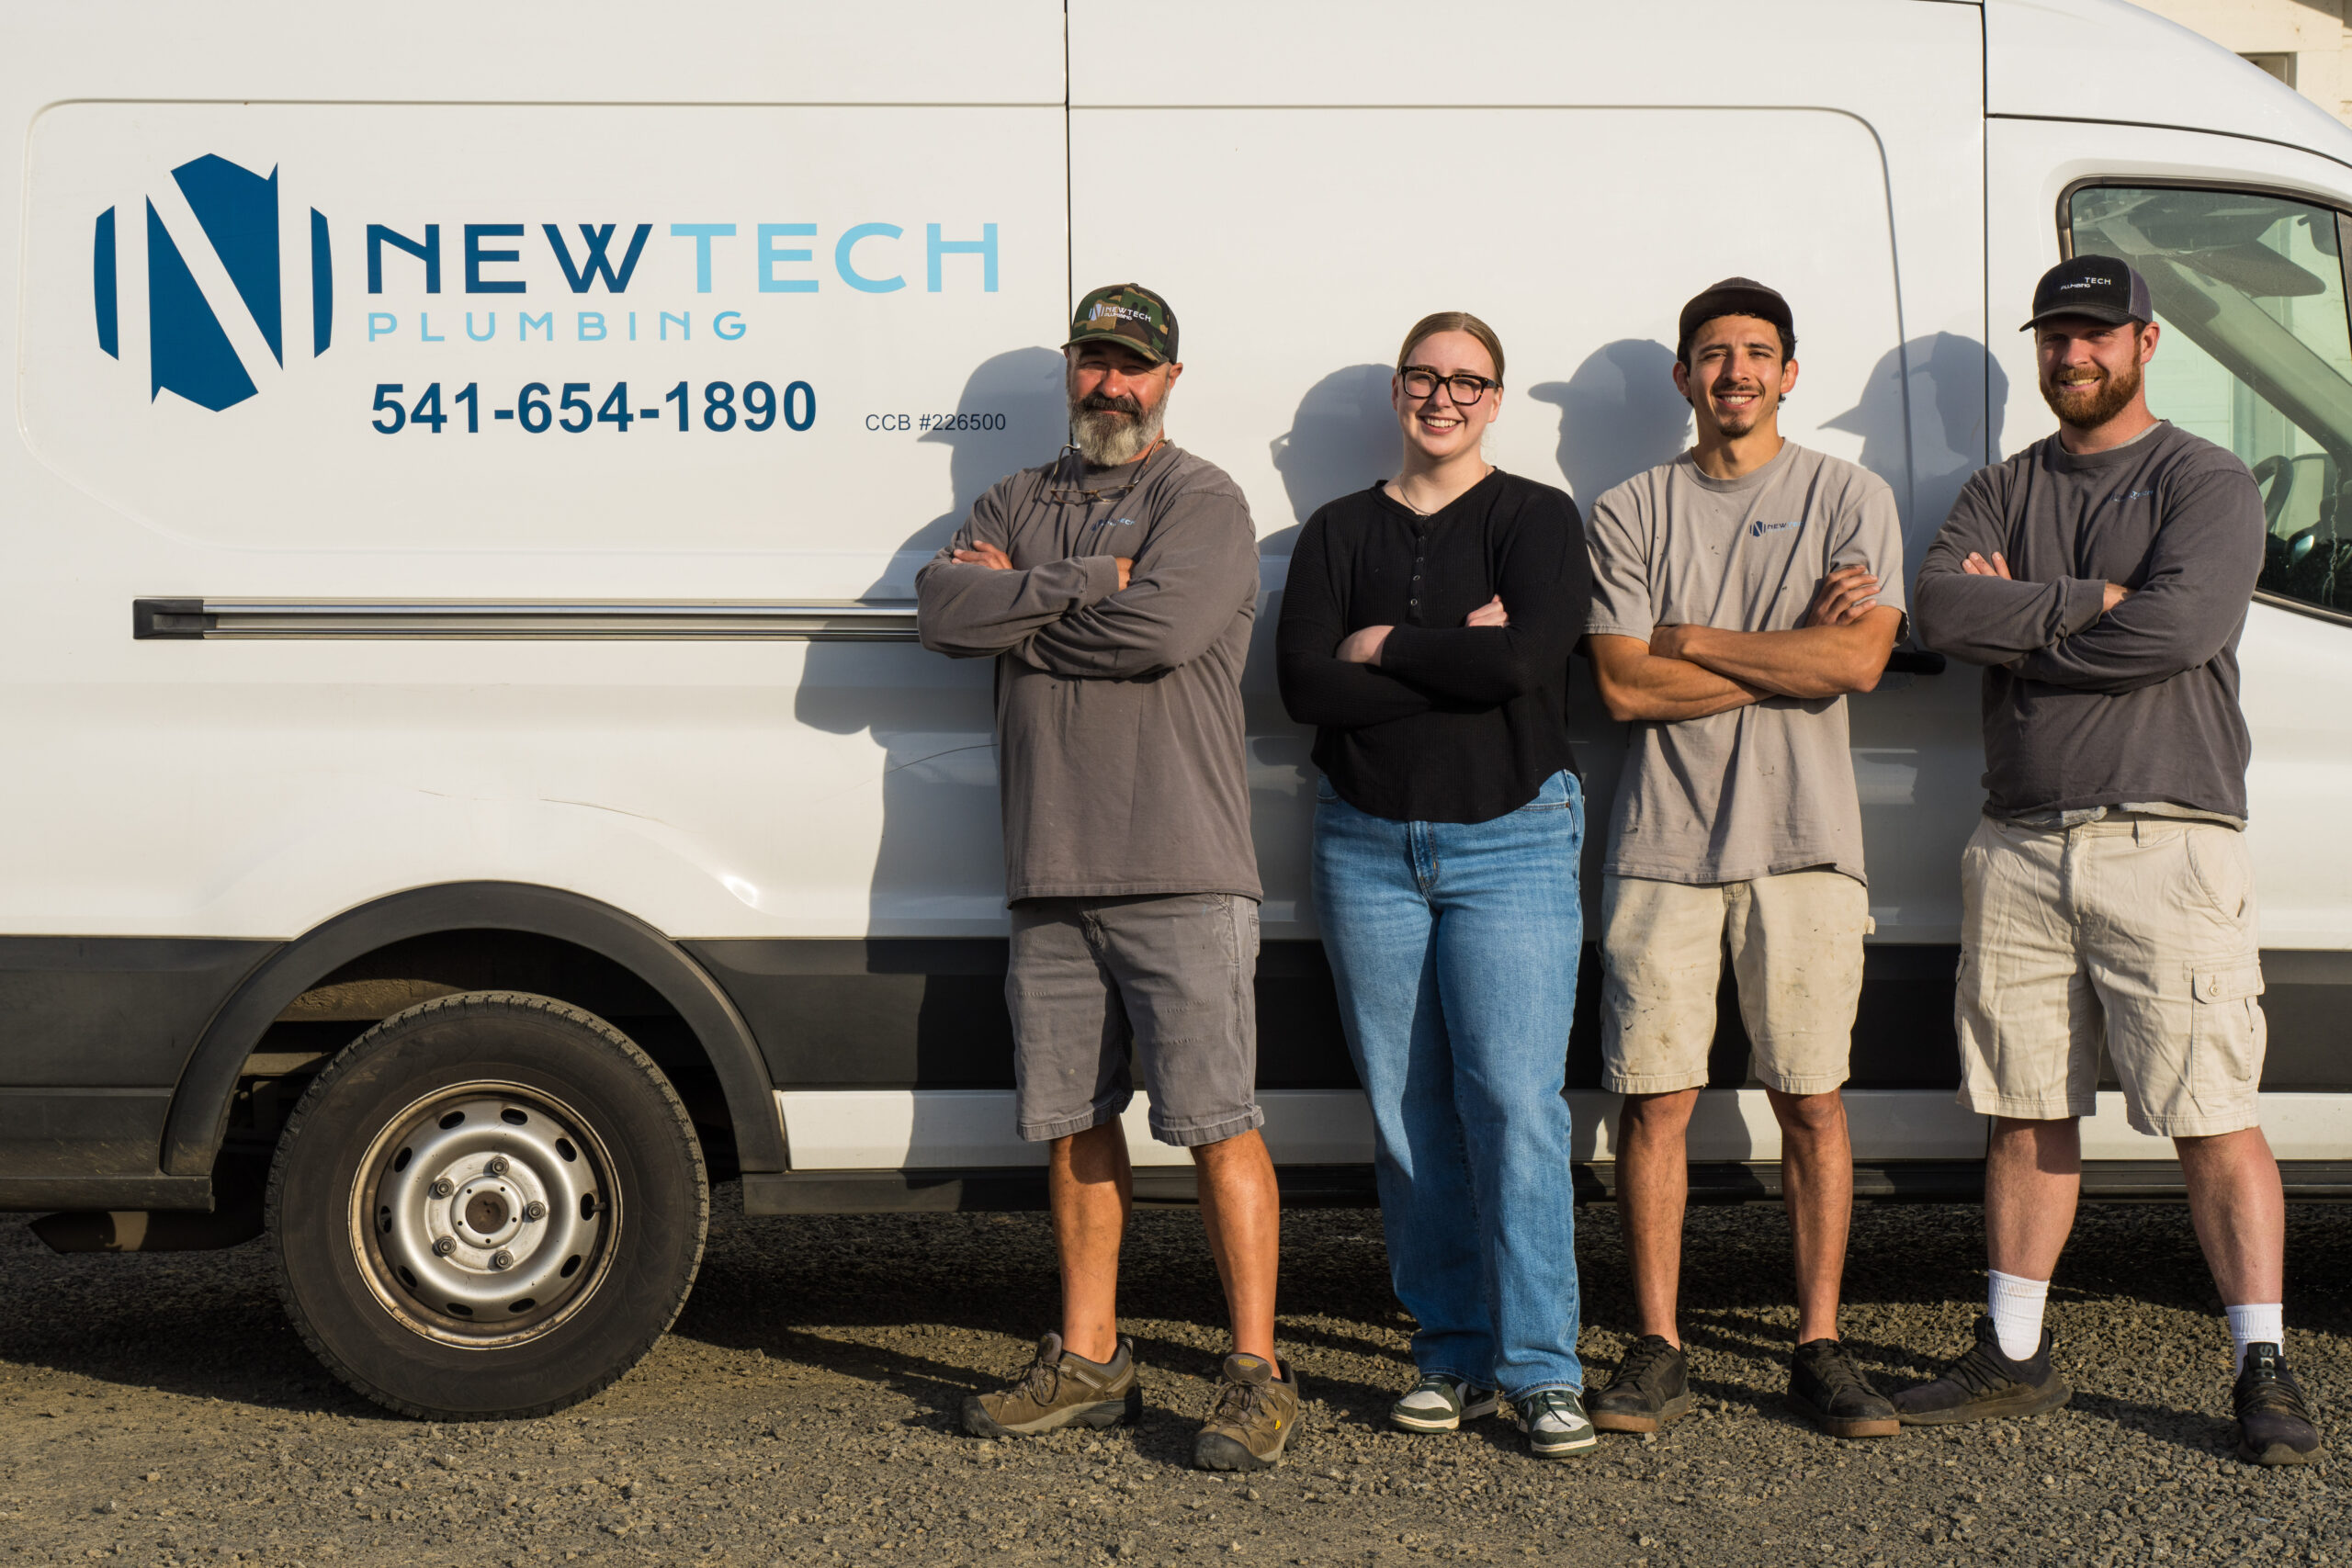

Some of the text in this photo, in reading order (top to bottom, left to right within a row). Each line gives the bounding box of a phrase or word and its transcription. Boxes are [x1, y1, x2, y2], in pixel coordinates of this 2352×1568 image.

[1104, 306, 1152, 322] NEWTECH
[368, 311, 747, 342] PLUMBING
[372, 380, 817, 434] 541-654-1890
[865, 413, 1006, 431] CCB #226500
